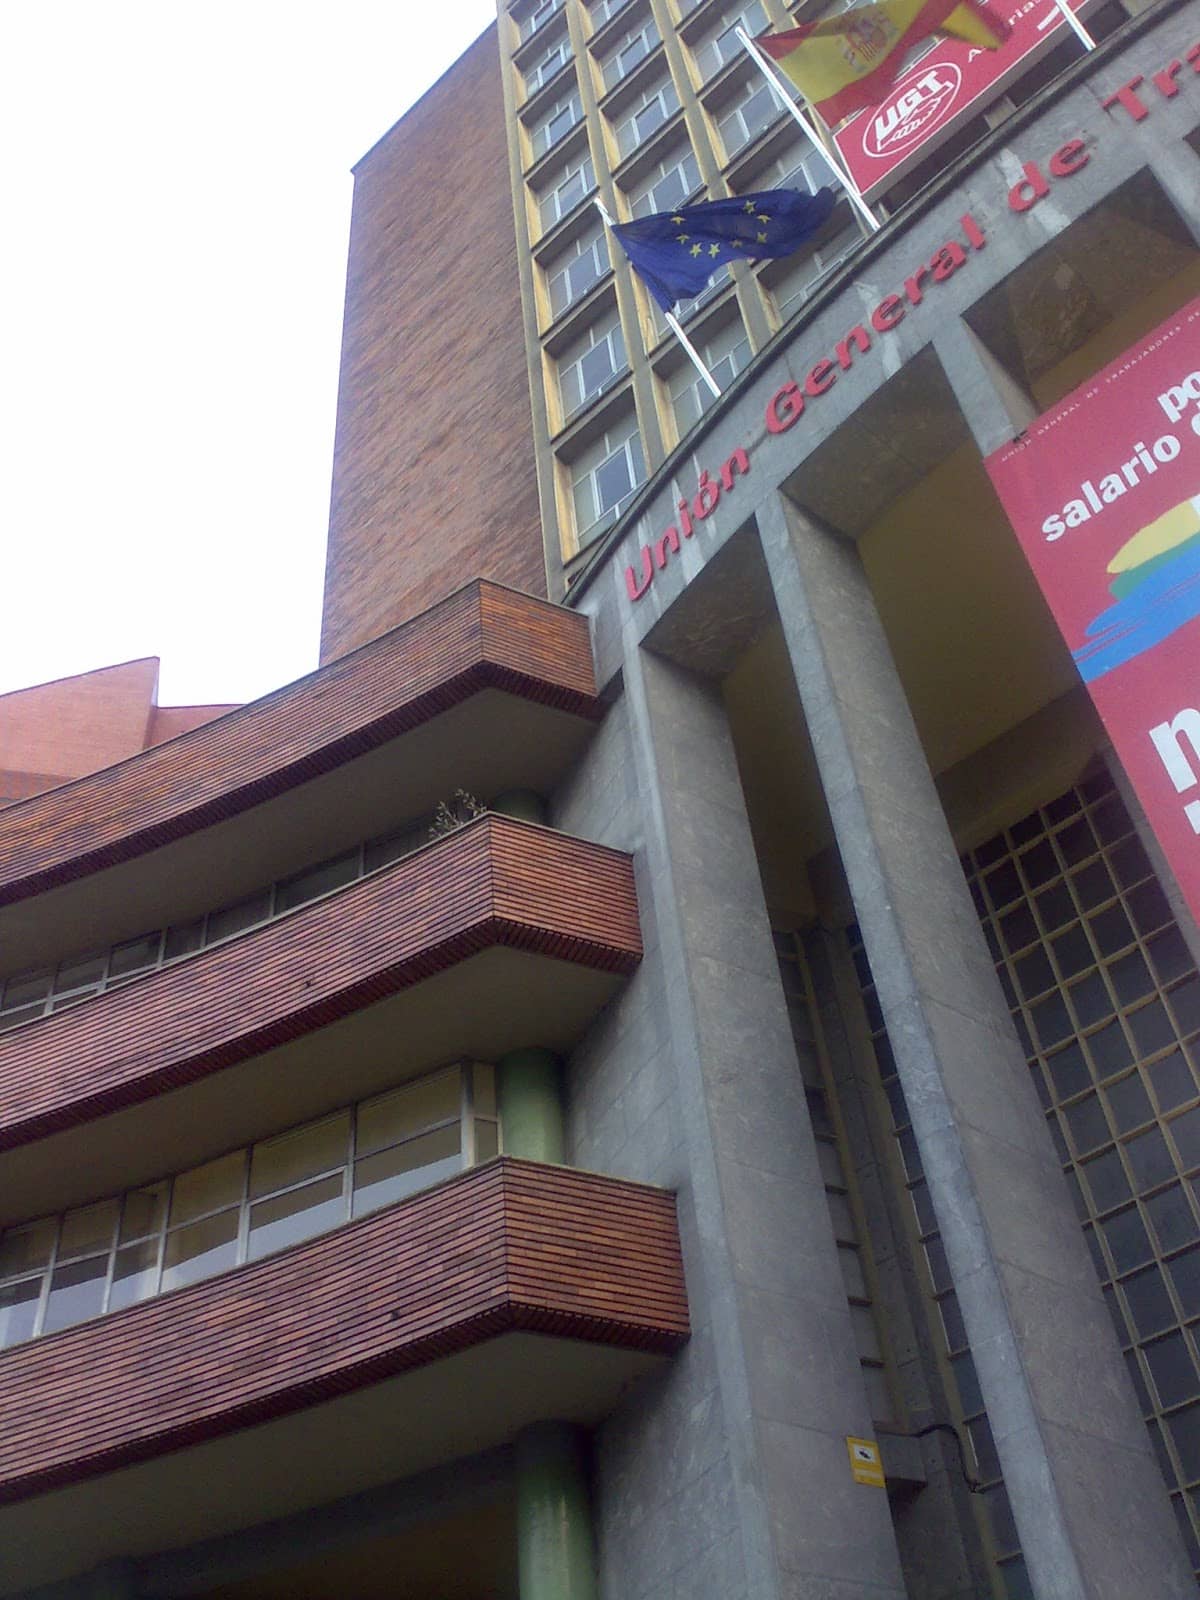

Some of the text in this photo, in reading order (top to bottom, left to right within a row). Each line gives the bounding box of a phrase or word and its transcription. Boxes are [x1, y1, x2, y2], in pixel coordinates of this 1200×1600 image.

[875, 70, 941, 141] UGT
[625, 447, 749, 602] Unión
[765, 212, 986, 434] General
[1007, 138, 1090, 213] de
[1042, 435, 1181, 542] salario
